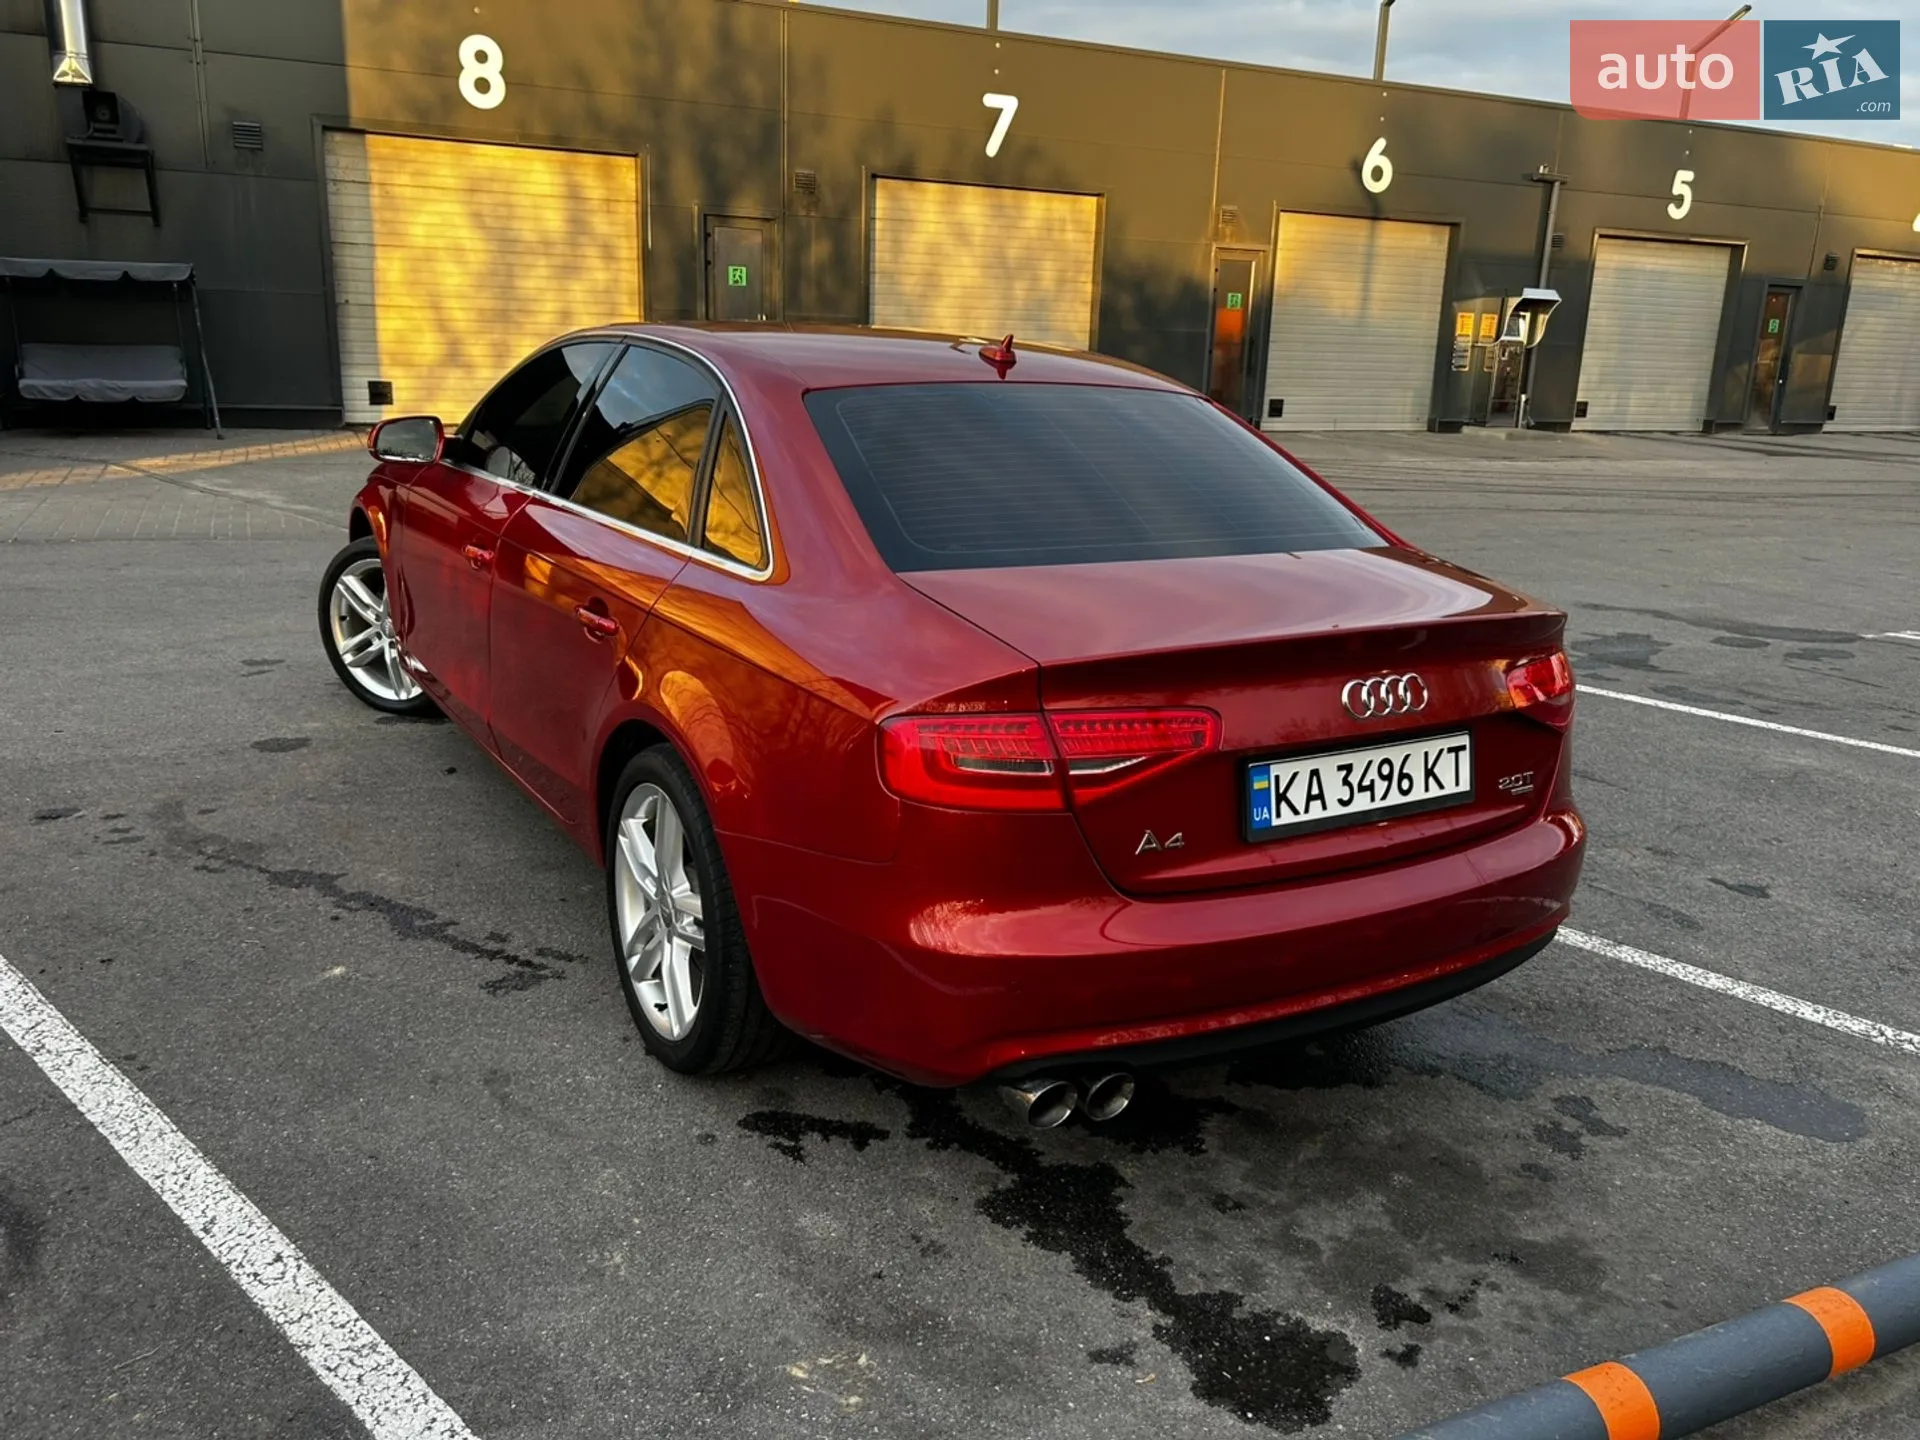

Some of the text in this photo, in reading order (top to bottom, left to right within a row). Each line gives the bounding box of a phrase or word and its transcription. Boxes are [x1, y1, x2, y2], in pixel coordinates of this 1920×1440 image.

[459, 34, 506, 110] 8
[982, 93, 1019, 158] 7
[1361, 137, 1394, 194] 6
[1667, 170, 1695, 220] 5
[1273, 744, 1467, 819] KA 3496 KT
[1135, 829, 1185, 855] A4
[1253, 808, 1270, 821] UA
